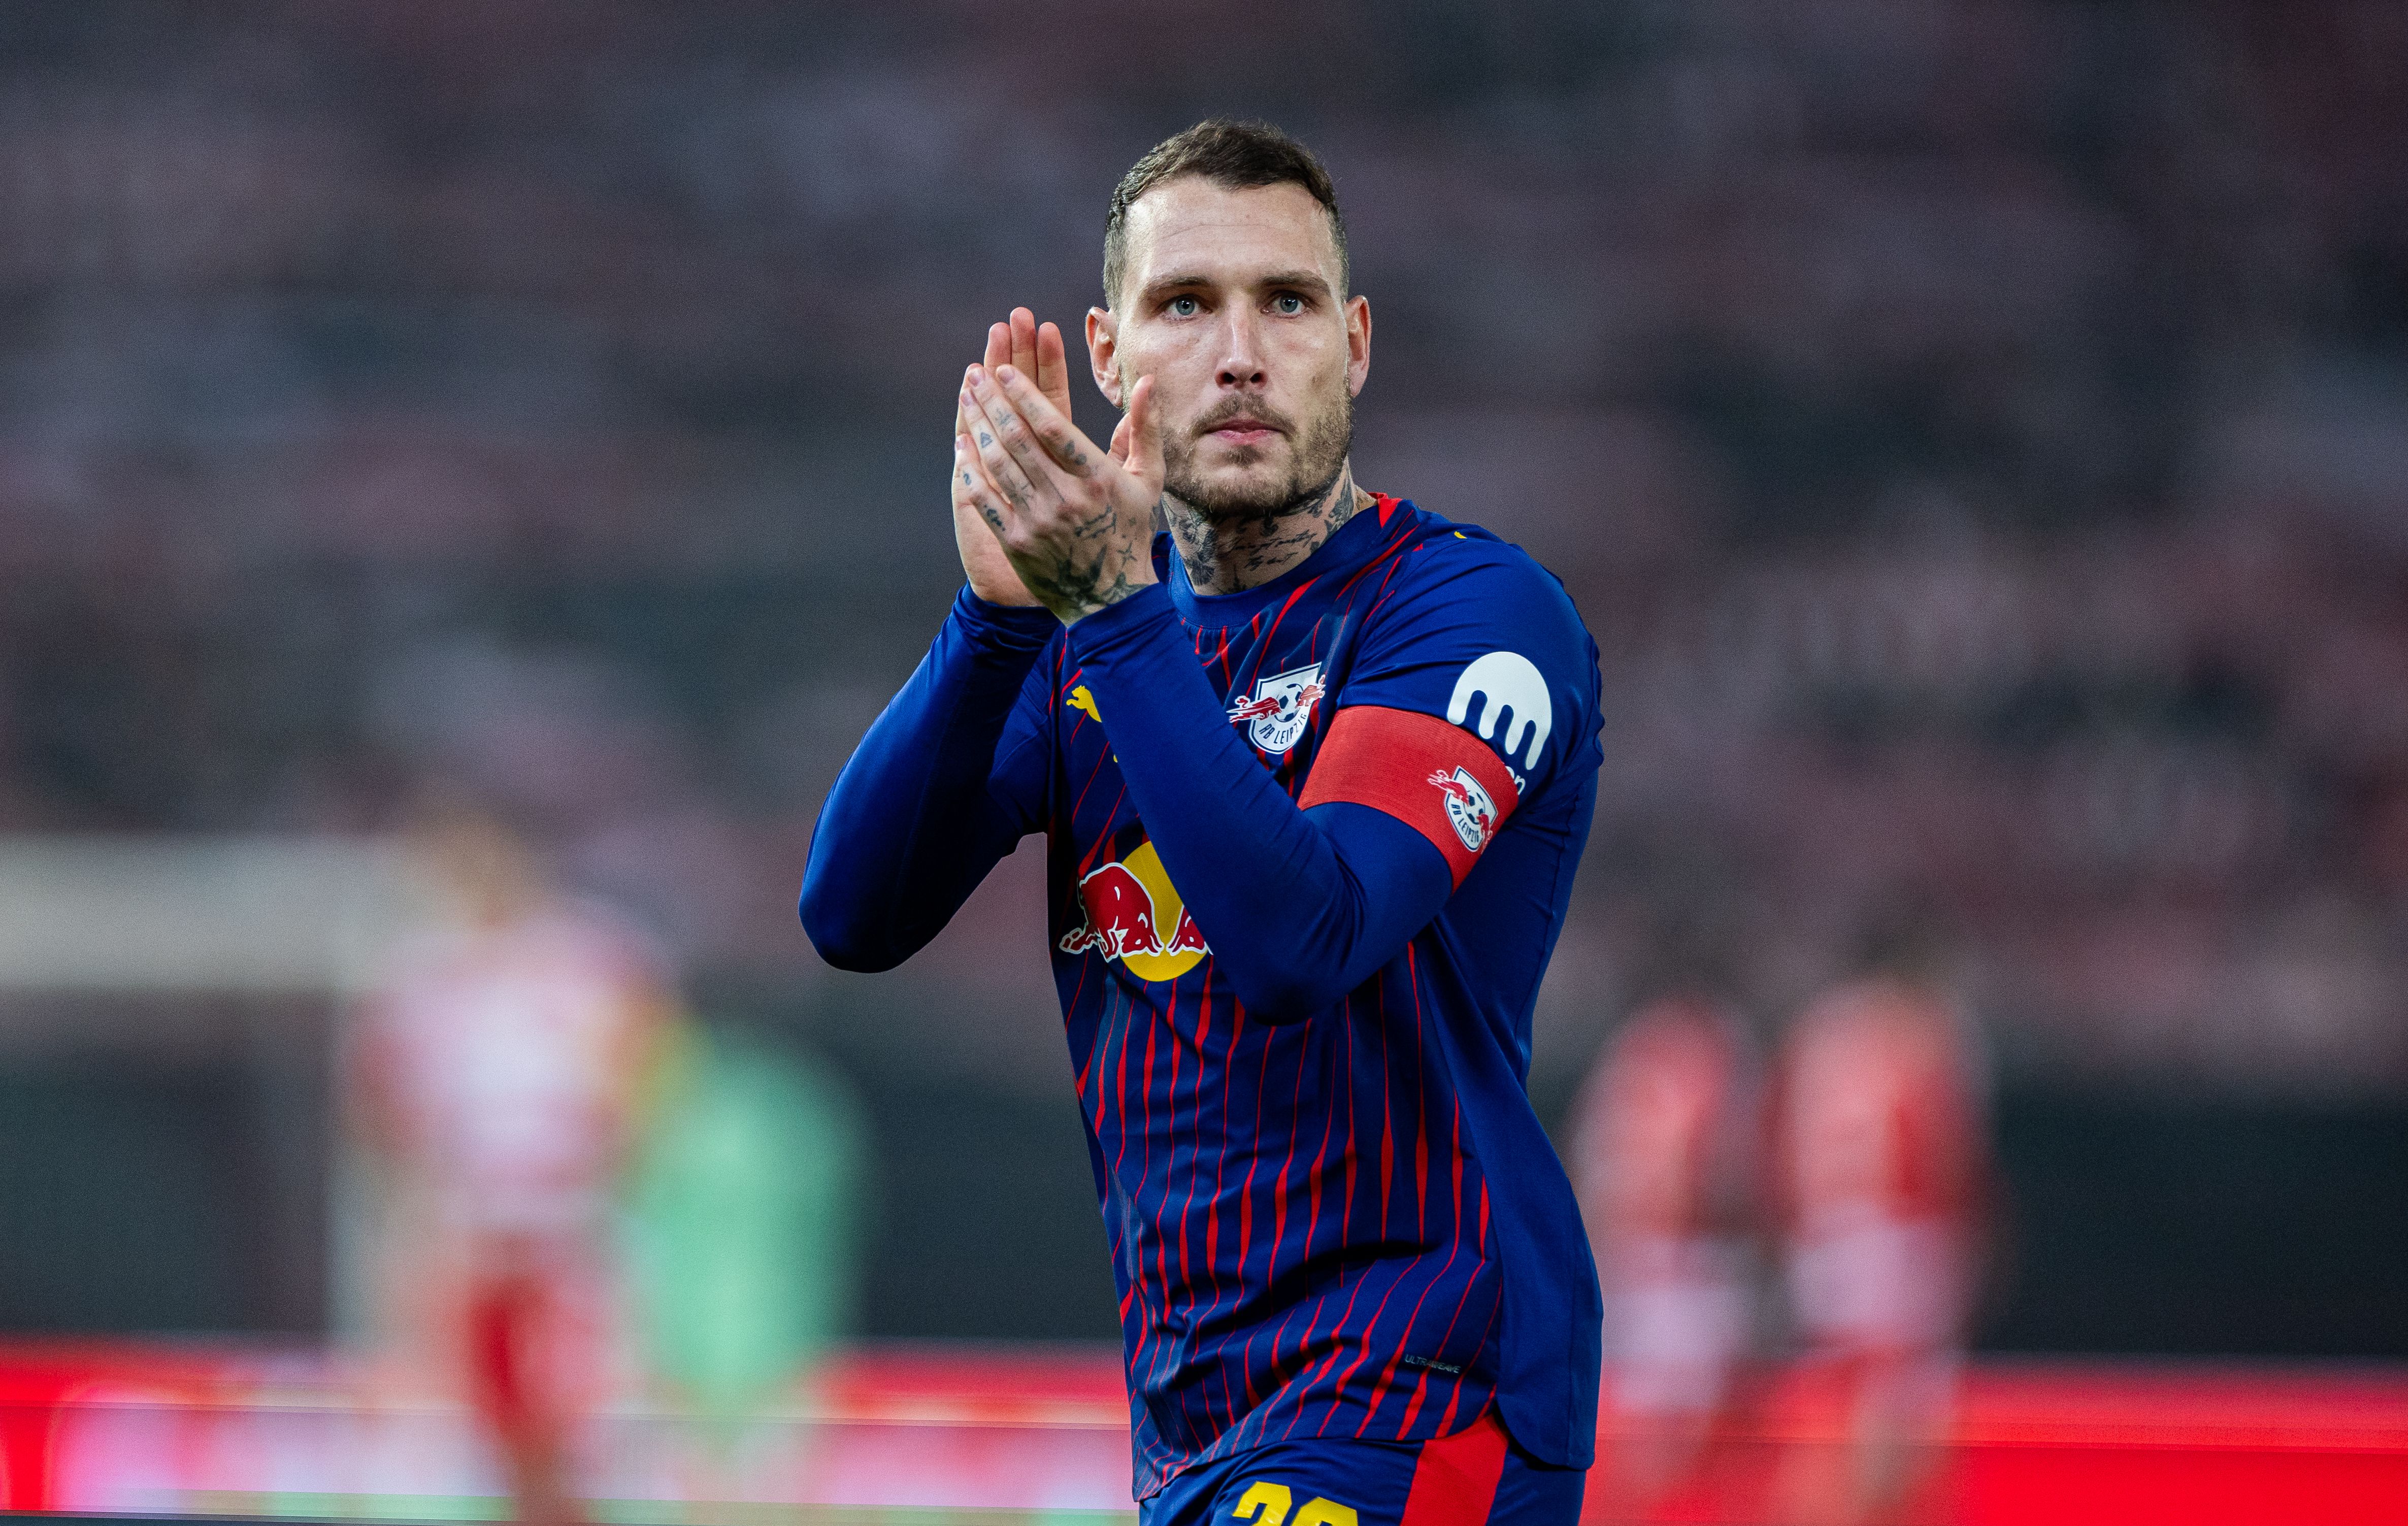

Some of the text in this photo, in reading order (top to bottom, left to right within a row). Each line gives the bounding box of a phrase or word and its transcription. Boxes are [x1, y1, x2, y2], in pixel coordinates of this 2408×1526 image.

[1259, 713, 1307, 744] RB LEIPZIG
[1450, 804, 1479, 843] RB LEIPZIG
